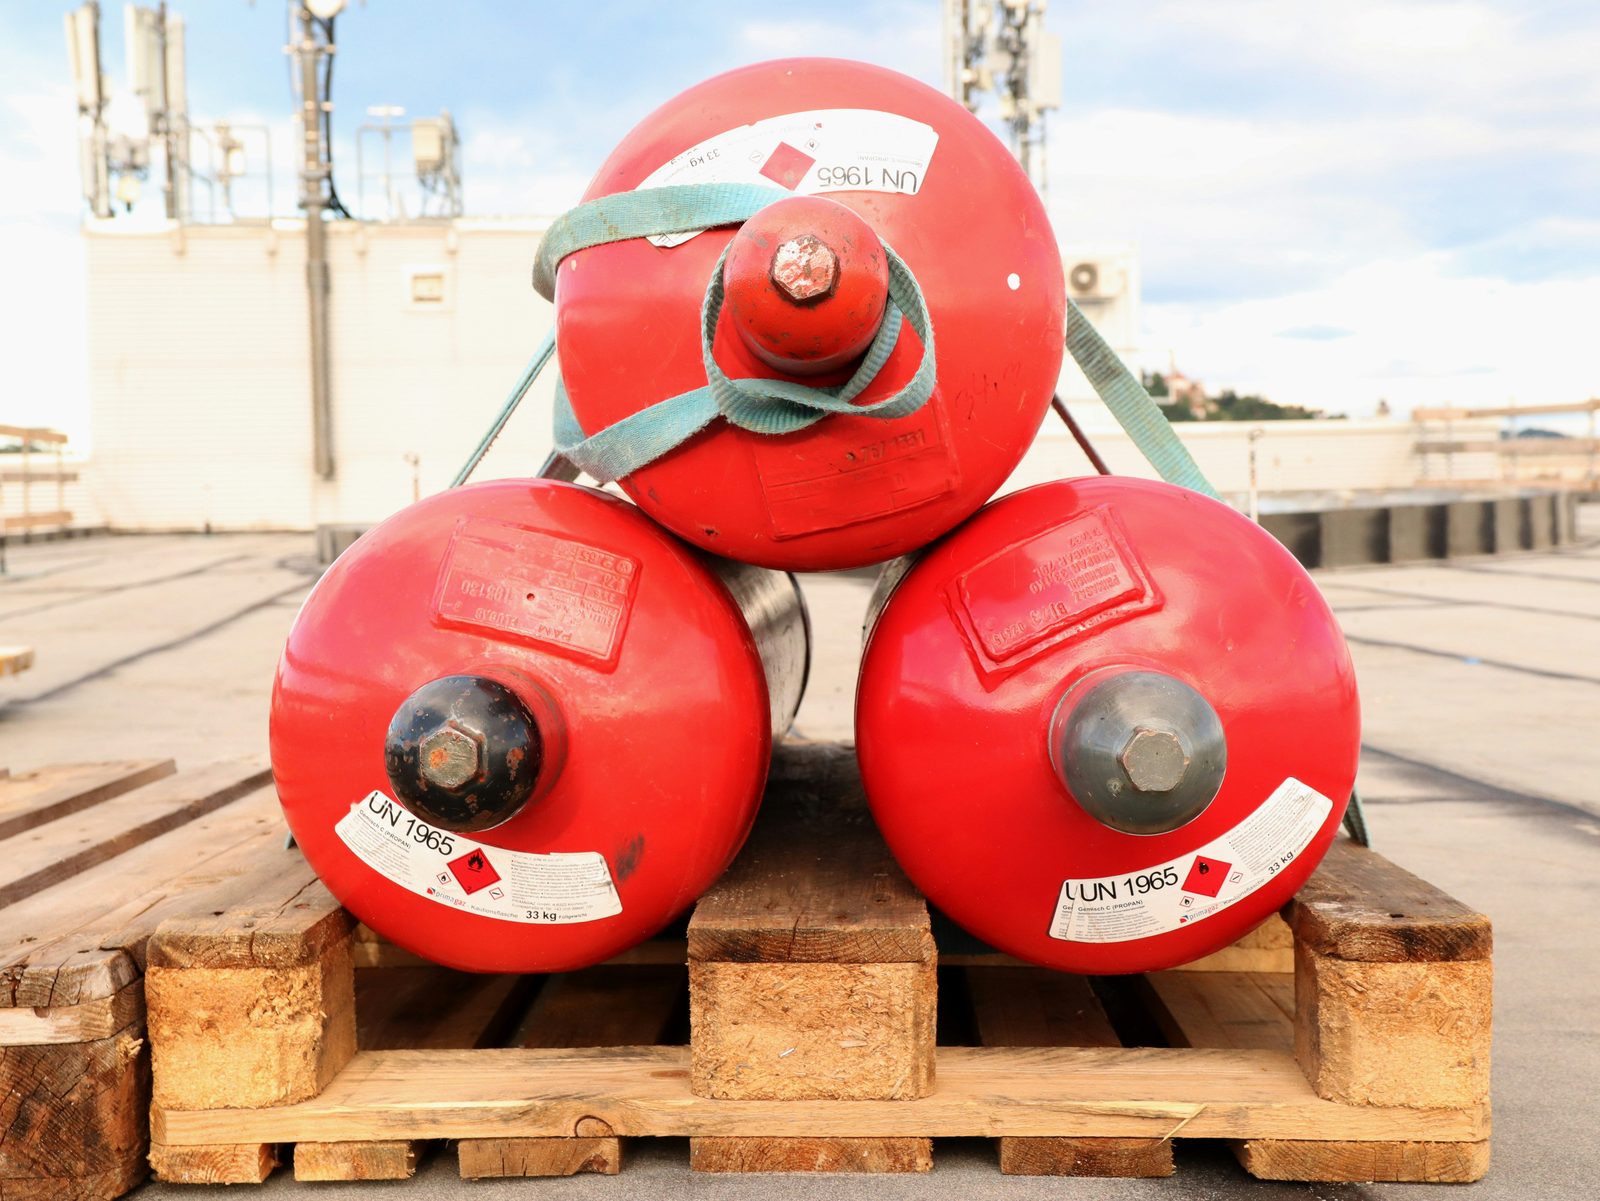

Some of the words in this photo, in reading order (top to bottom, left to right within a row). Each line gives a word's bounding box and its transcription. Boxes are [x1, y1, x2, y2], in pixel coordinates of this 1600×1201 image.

[688, 155, 704, 168] kg
[705, 147, 720, 161] 33
[816, 165, 873, 187] 1965
[881, 166, 917, 192] UN
[368, 791, 403, 827] UN
[405, 819, 456, 856] 1965
[1079, 881, 1117, 902] UN
[1123, 866, 1179, 897] 1965
[1189, 903, 1219, 921] primagaz
[1268, 862, 1281, 876] 33
[1281, 850, 1295, 865] kg
[435, 890, 467, 908] primagaz
[525, 910, 540, 920] 33
[542, 910, 557, 922] kg
[1112, 899, 1144, 912] (PROPAN)
